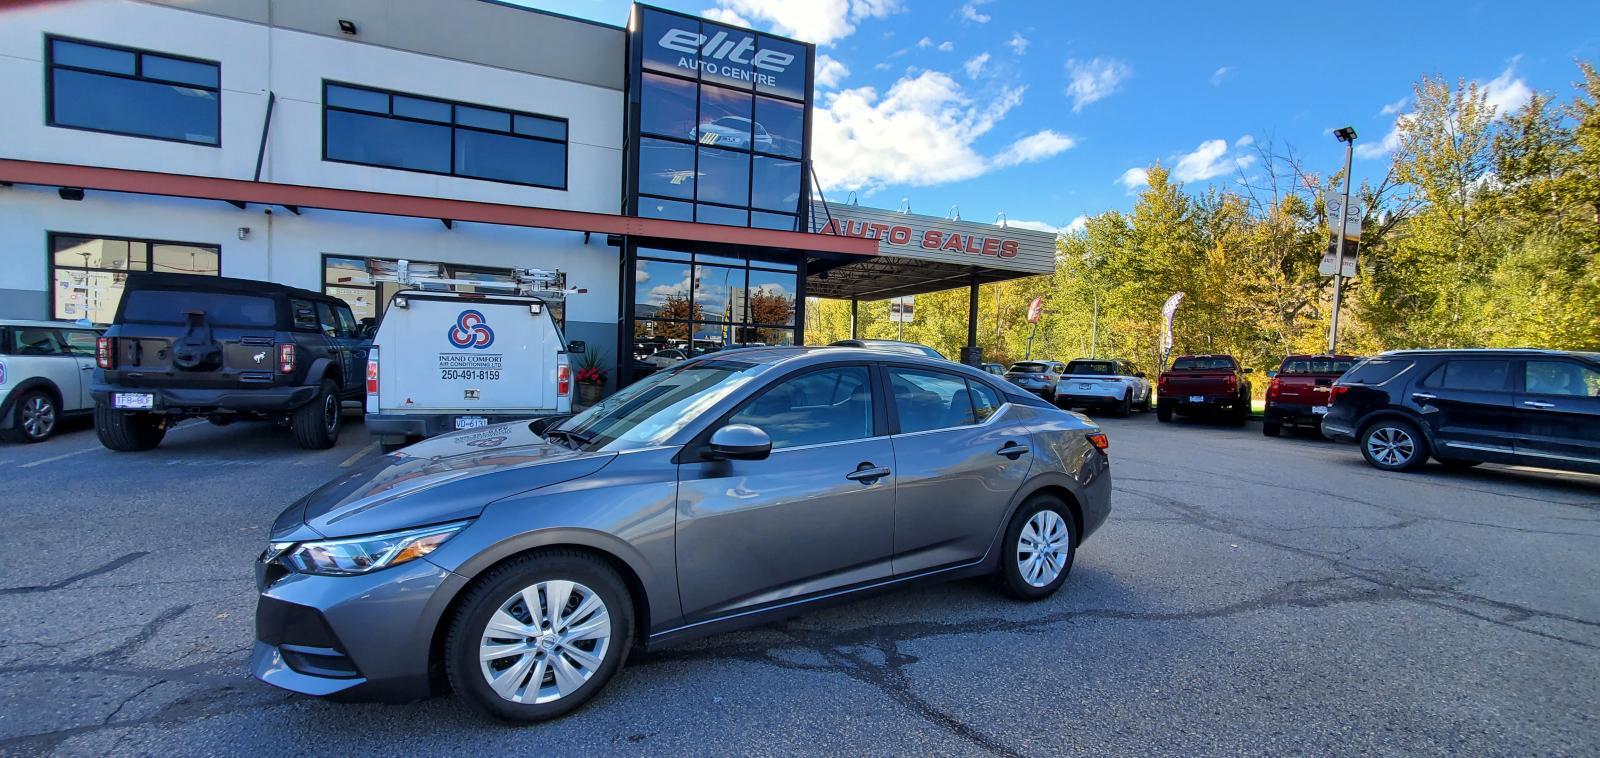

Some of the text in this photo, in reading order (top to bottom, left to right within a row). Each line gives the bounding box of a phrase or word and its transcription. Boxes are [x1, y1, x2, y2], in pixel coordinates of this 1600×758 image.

[658, 28, 795, 73] elite
[677, 56, 776, 87] AUTO CENTRE
[818, 218, 1020, 258] AUTO SALES
[442, 370, 500, 380] 250-491-8159
